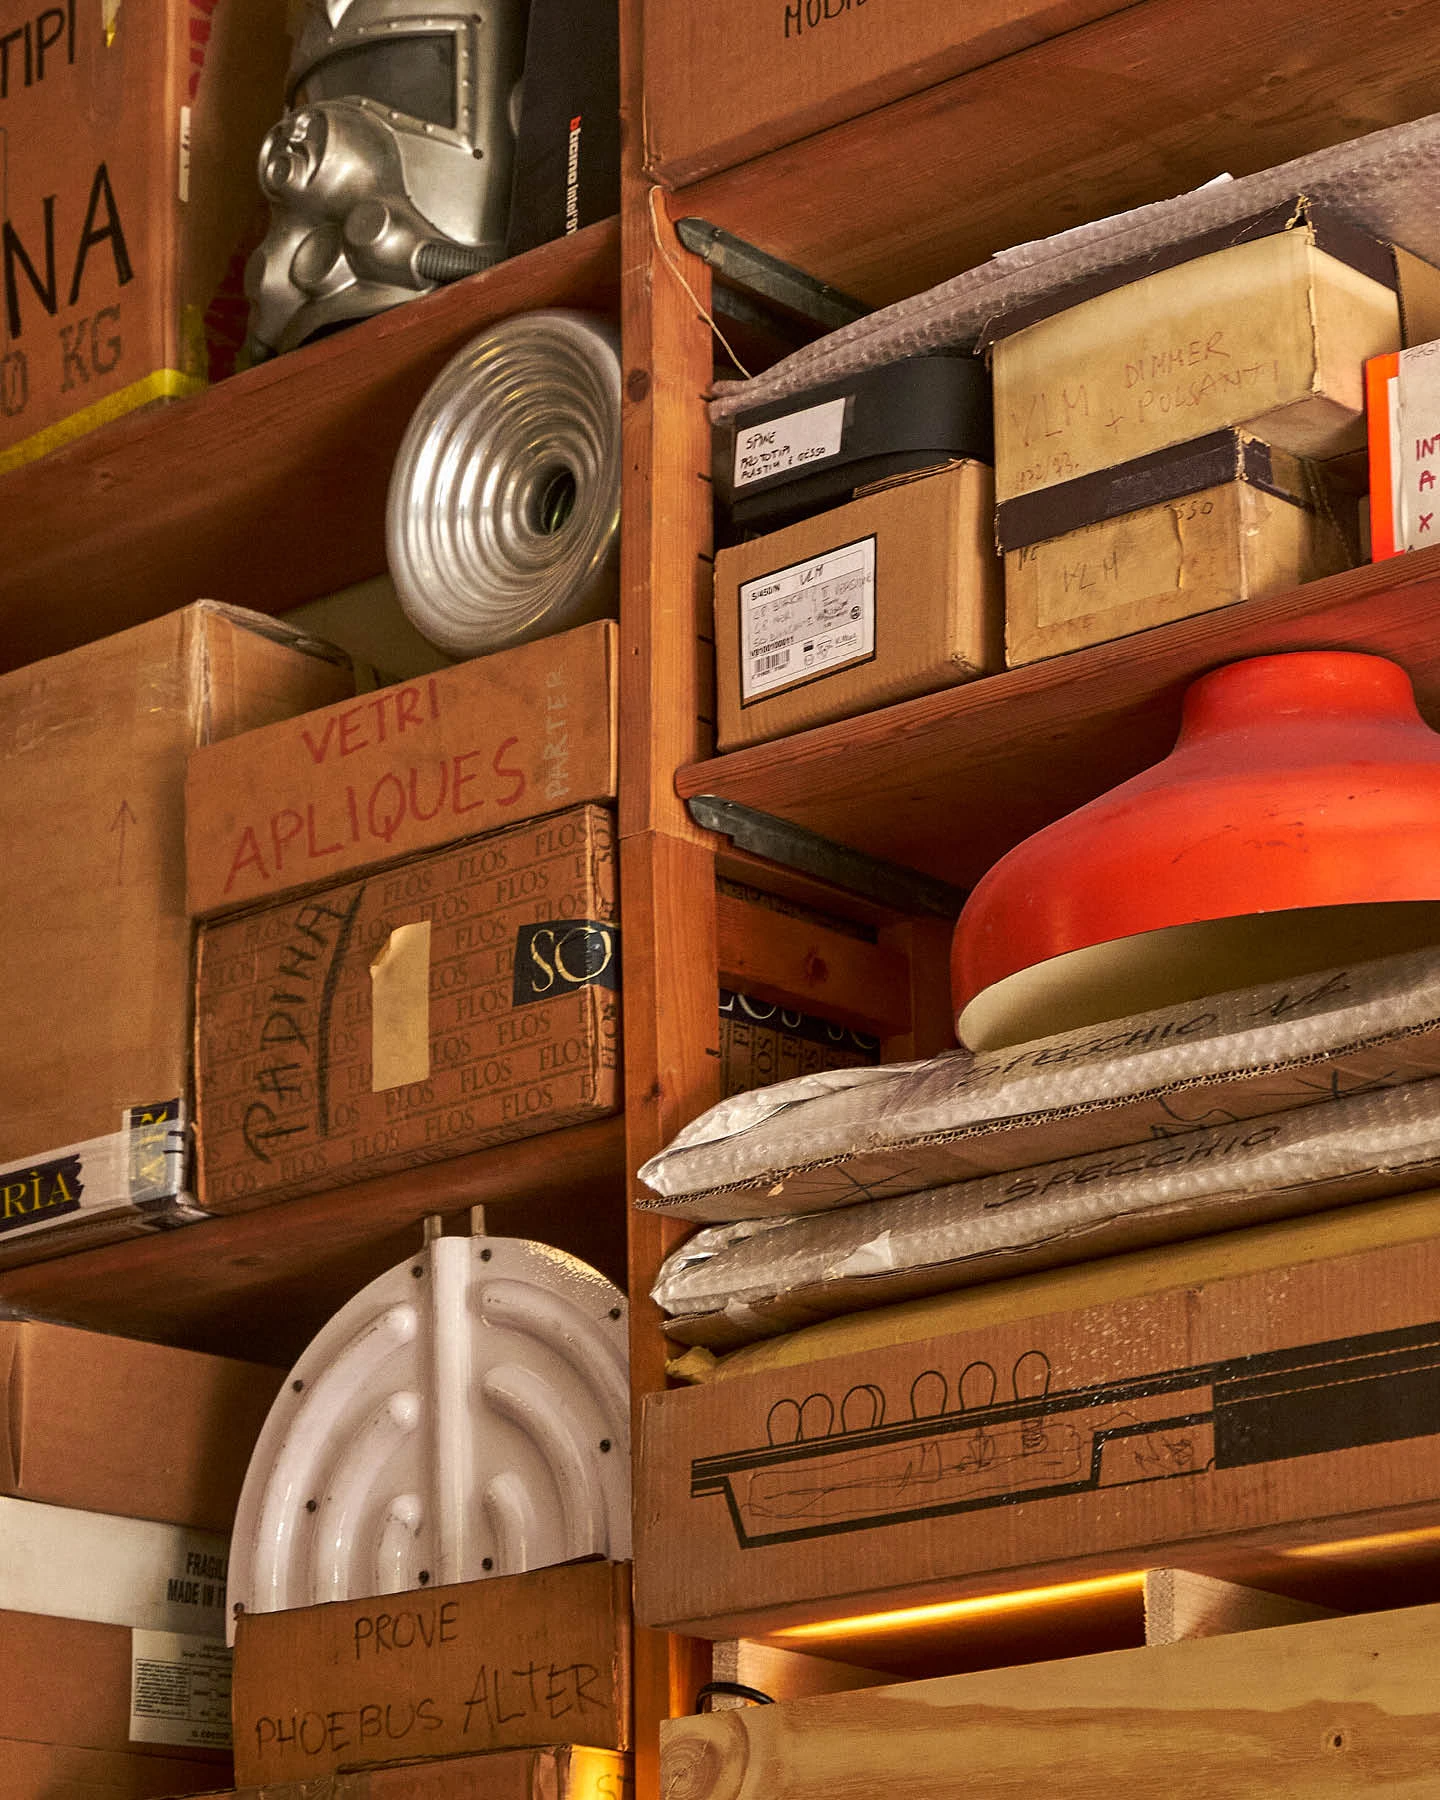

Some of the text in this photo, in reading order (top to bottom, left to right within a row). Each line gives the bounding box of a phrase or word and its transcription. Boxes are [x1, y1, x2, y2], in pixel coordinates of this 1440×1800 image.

[58, 302, 122, 393] KG
[1419, 469, 1437, 493] A
[1419, 512, 1434, 533] X
[302, 678, 441, 765] VETRI
[224, 735, 528, 894] APLIQUES
[457, 848, 508, 882] FLOS
[534, 816, 589, 857] FLOS
[496, 865, 549, 903] FLOS
[455, 919, 506, 951] FLOS
[534, 888, 588, 922] FLOS
[455, 984, 510, 1021] FLOS
[496, 1007, 551, 1046] FLOS
[459, 1056, 513, 1094] FLOS
[538, 1035, 592, 1073] FLOS
[953, 1013, 1217, 1087] SPECCHIO
[424, 1105, 476, 1143] FLOS
[501, 1083, 554, 1121] FLOS
[983, 1125, 1281, 1208] SPECCHIO
[167, 1578, 200, 1606] MADE
[202, 1581, 214, 1609] IN
[354, 1602, 459, 1659] PROVE
[255, 1661, 607, 1760] PHOEBUS ALTER
